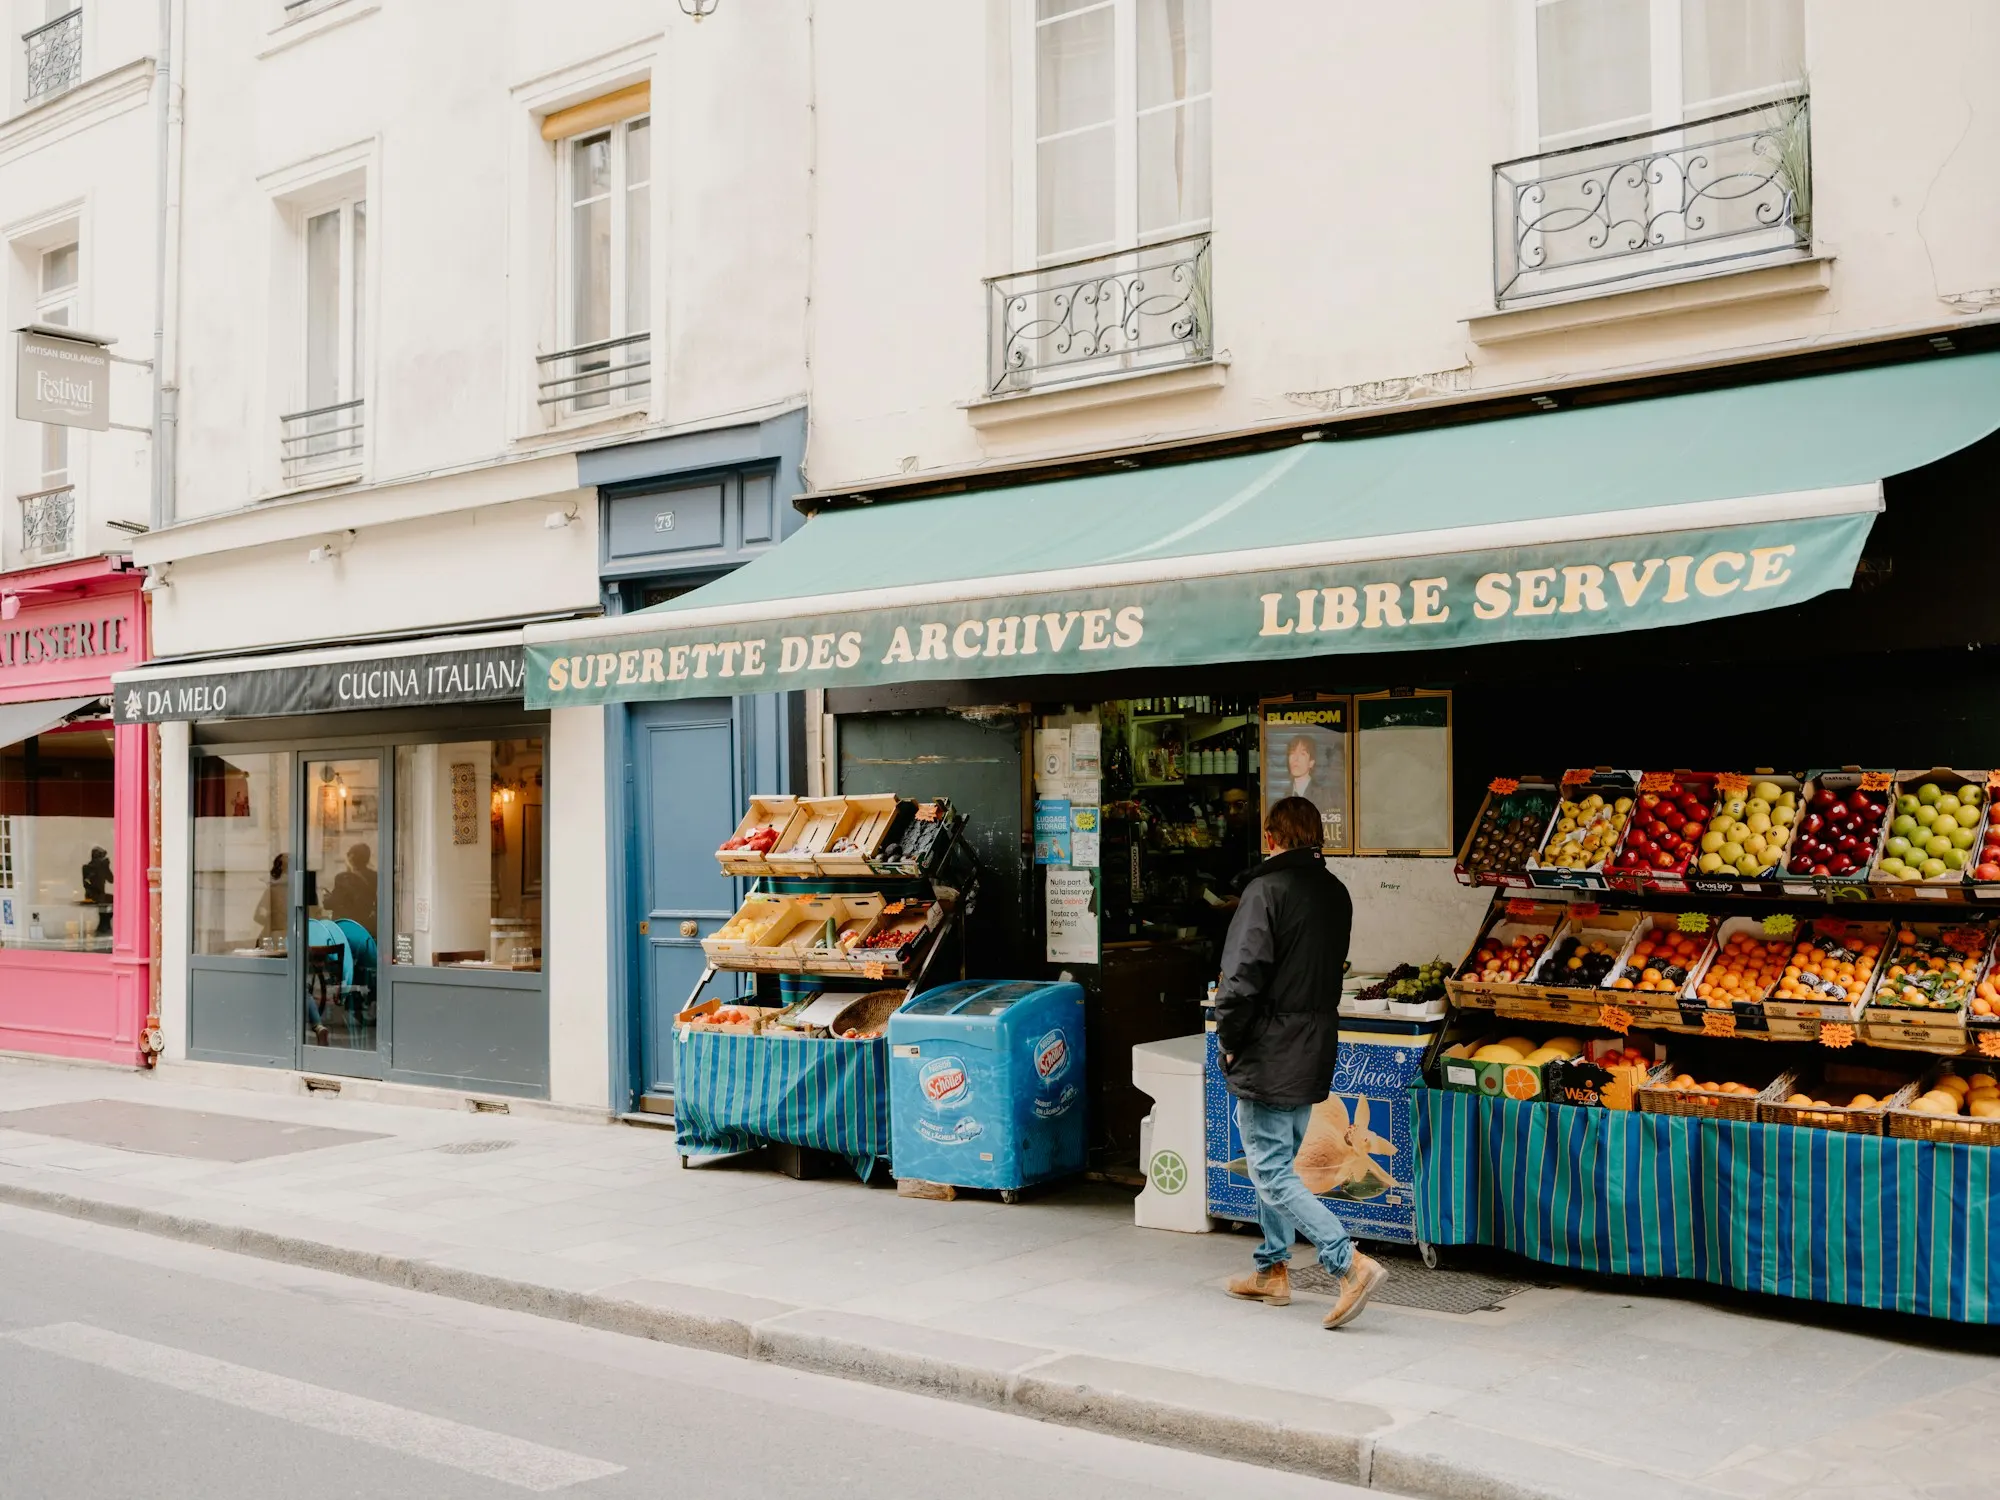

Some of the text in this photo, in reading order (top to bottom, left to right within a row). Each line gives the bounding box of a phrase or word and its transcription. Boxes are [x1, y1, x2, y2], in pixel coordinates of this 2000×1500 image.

[25, 344, 105, 367] ARTISAN BOULANGER
[36, 370, 94, 404] Festival
[658, 514, 672, 529] 73
[1259, 544, 1796, 637] LIBRE SERVICE
[0, 614, 128, 668] TISSERIE
[548, 605, 1145, 692] SUPERETTE DES ARCHIVES
[338, 667, 420, 700] CUCINA
[147, 685, 227, 716] DA MELO
[1267, 709, 1341, 725] BLOWSOM
[1036, 815, 1067, 823] LUGGAGE
[1321, 813, 1341, 823] 5.26
[1323, 823, 1342, 841] ALE
[1050, 919, 1077, 928] KeyNest
[1333, 1047, 1404, 1092] Glaces
[927, 1072, 963, 1100] Schöller
